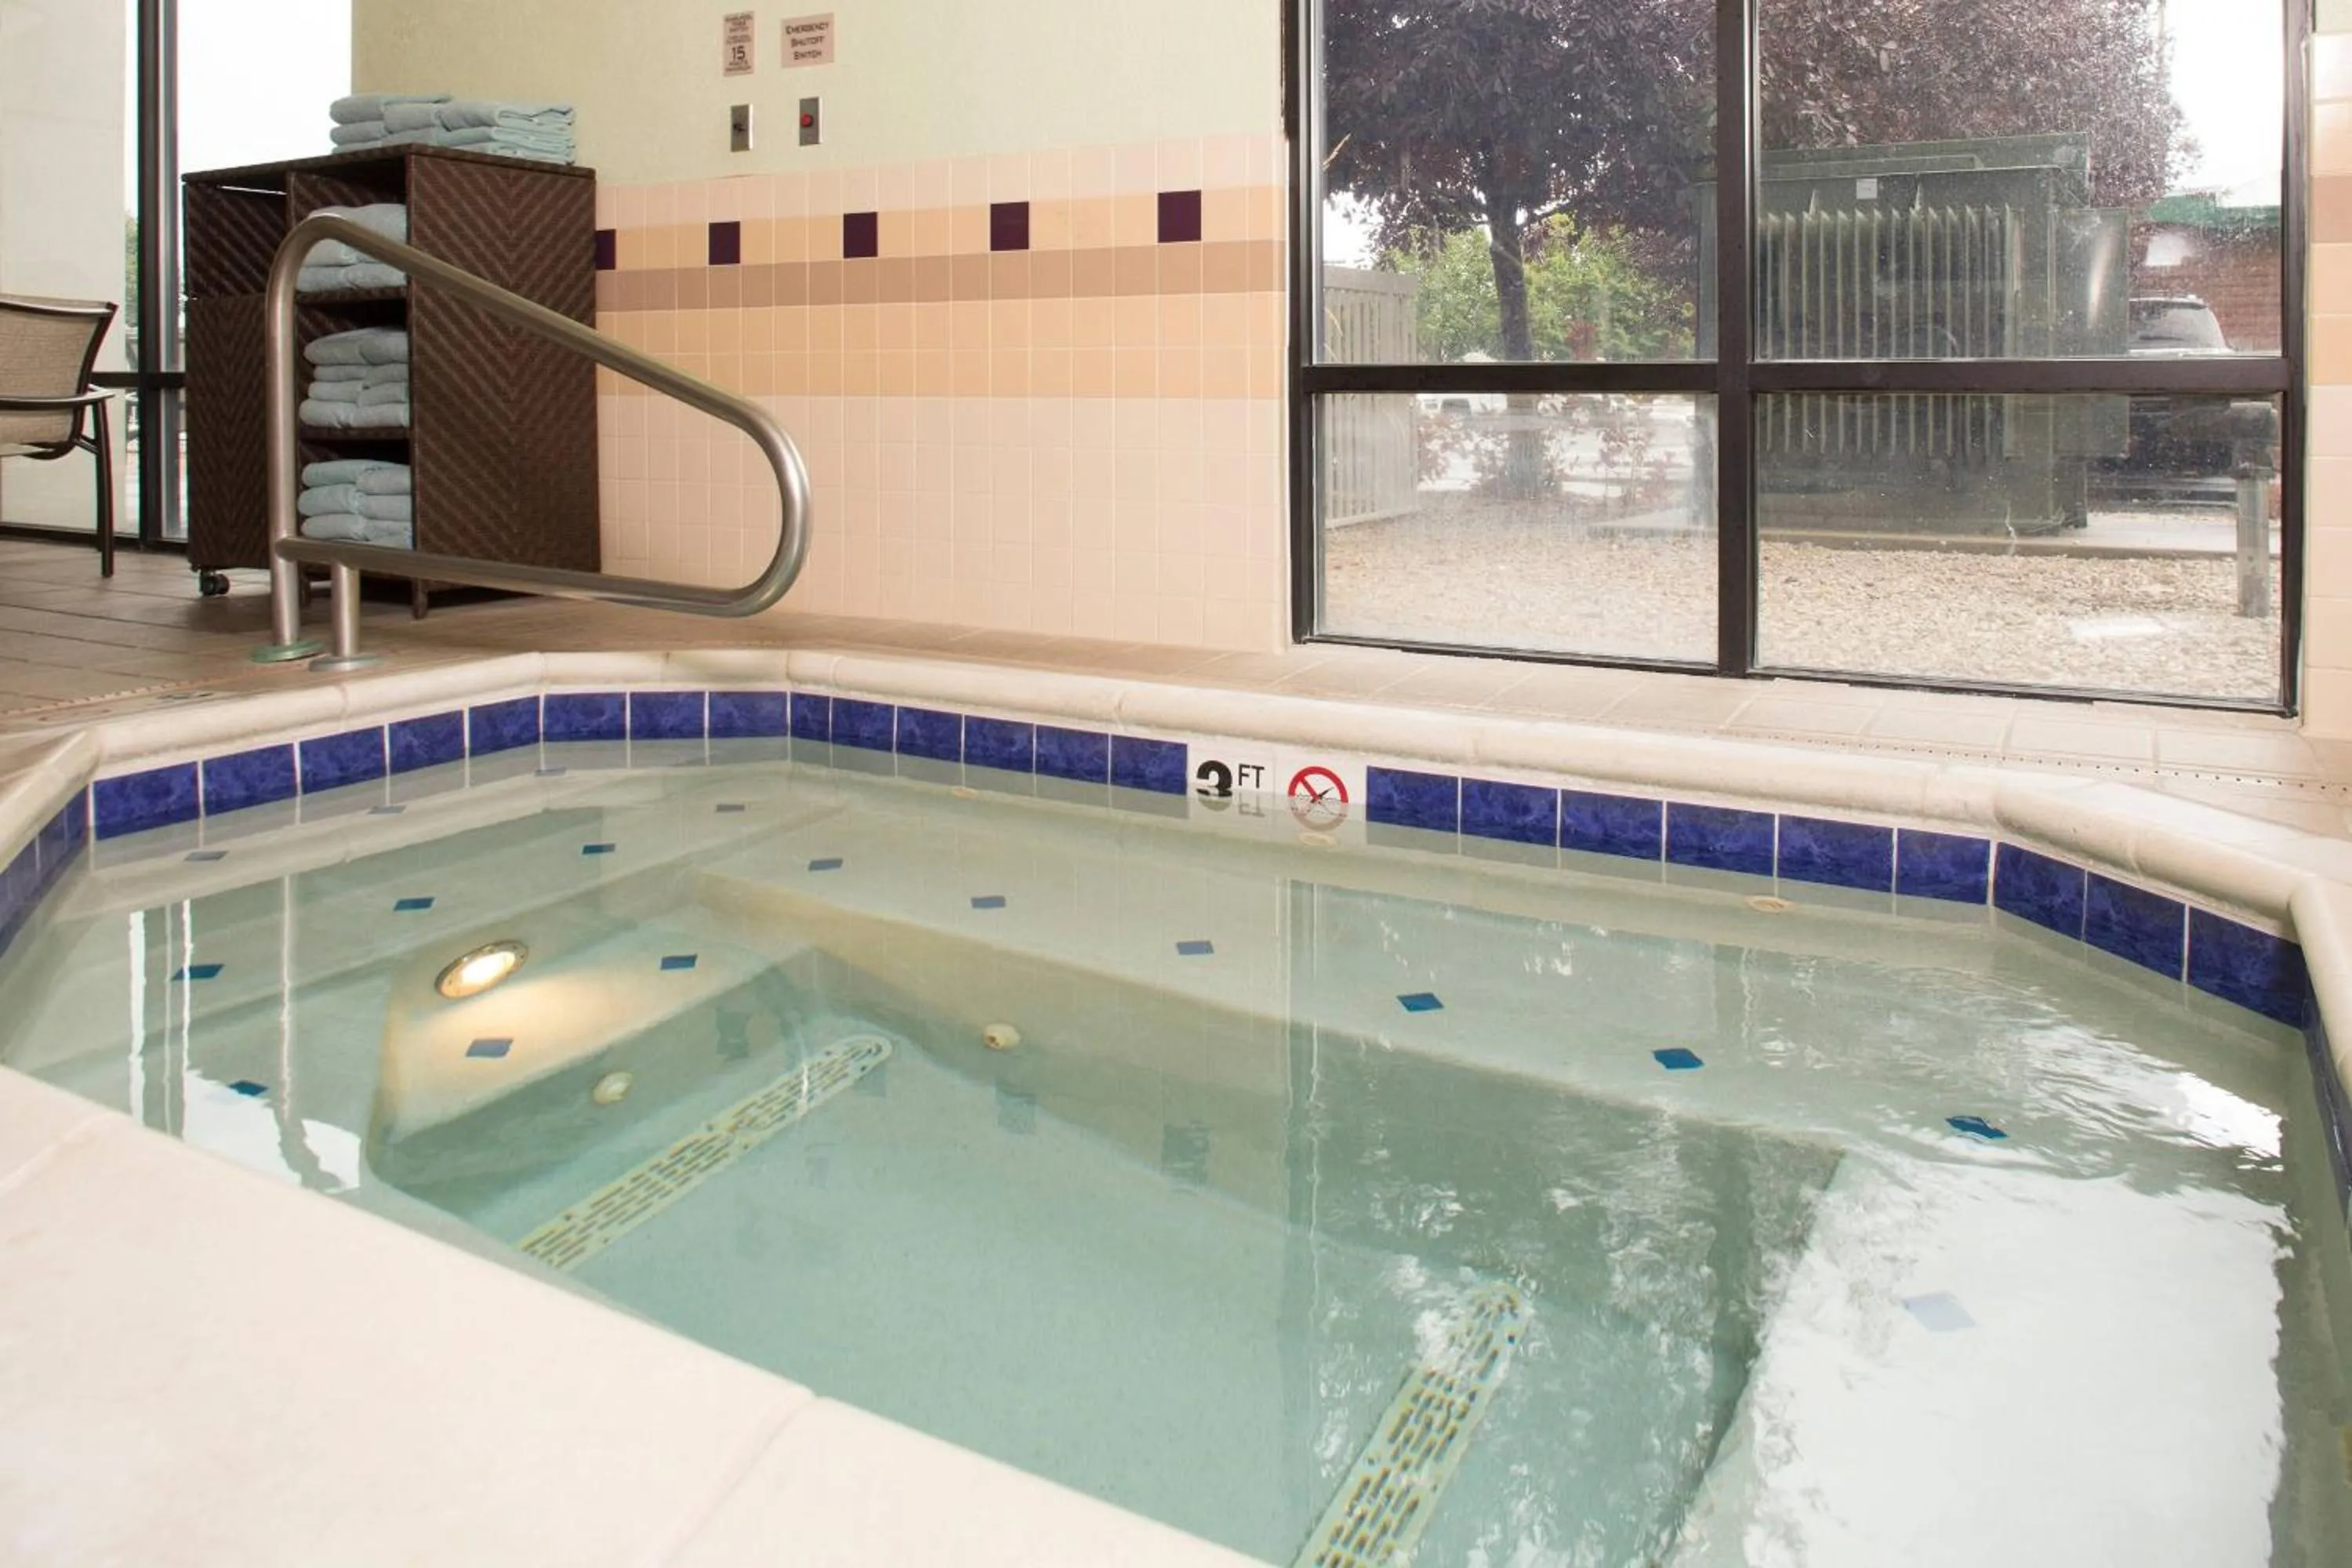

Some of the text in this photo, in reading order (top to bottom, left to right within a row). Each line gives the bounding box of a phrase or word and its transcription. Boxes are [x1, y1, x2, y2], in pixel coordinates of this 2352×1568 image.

[786, 22, 829, 34] EMERGENCY
[791, 36, 825, 47] SHUTOFF
[731, 45, 746, 60] 15
[793, 49, 822, 60] SWITCH
[1238, 764, 1265, 789] FT
